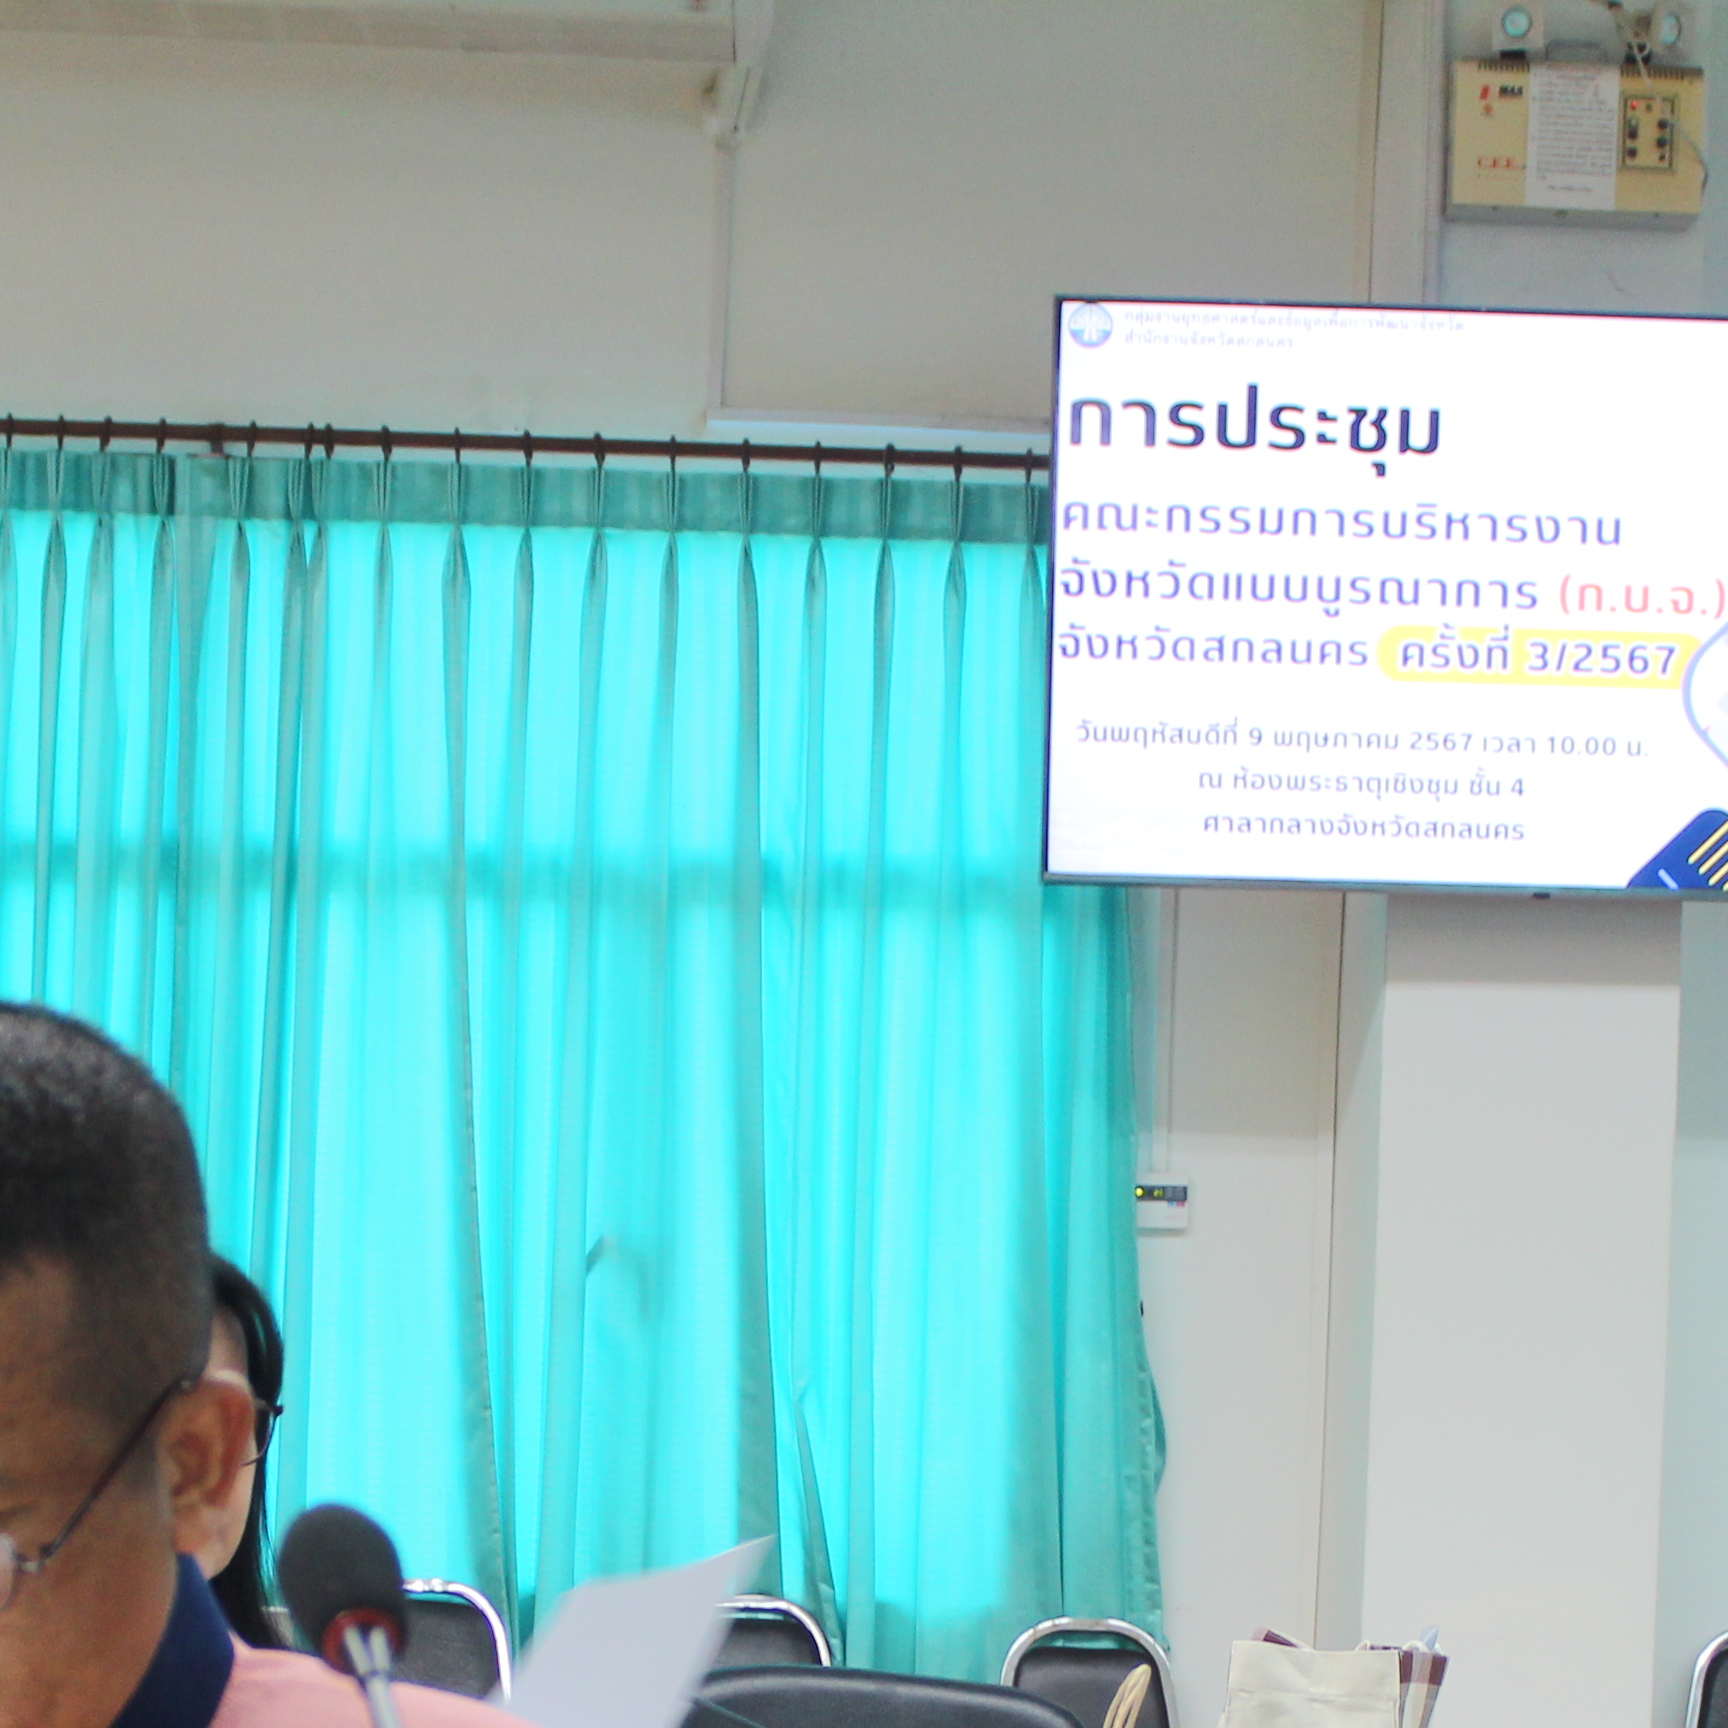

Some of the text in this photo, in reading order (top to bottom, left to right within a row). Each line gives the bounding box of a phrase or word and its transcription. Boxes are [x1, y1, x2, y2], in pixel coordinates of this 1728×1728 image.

[1069, 382, 1441, 478] การประชุม
[1062, 500, 1622, 546] คณะกรรมการบริหารงาน
[1059, 556, 1727, 621] จังหวัดแบบบูรณาการ (ก.บ.จ.)
[1058, 622, 1677, 676] จังหวัดสกลนคร ครั้งที่ 3/2567
[1076, 716, 1649, 758] วันพฤหัสบดีที่ 9 พฤษภาคม 2567 เวลา 10.00 น.
[1198, 765, 1525, 803] ณ ห้องพระธาตุเชิงชุม ชั้น 4
[1203, 812, 1525, 841] ศาลากลางจังหวัดสกลนคร
